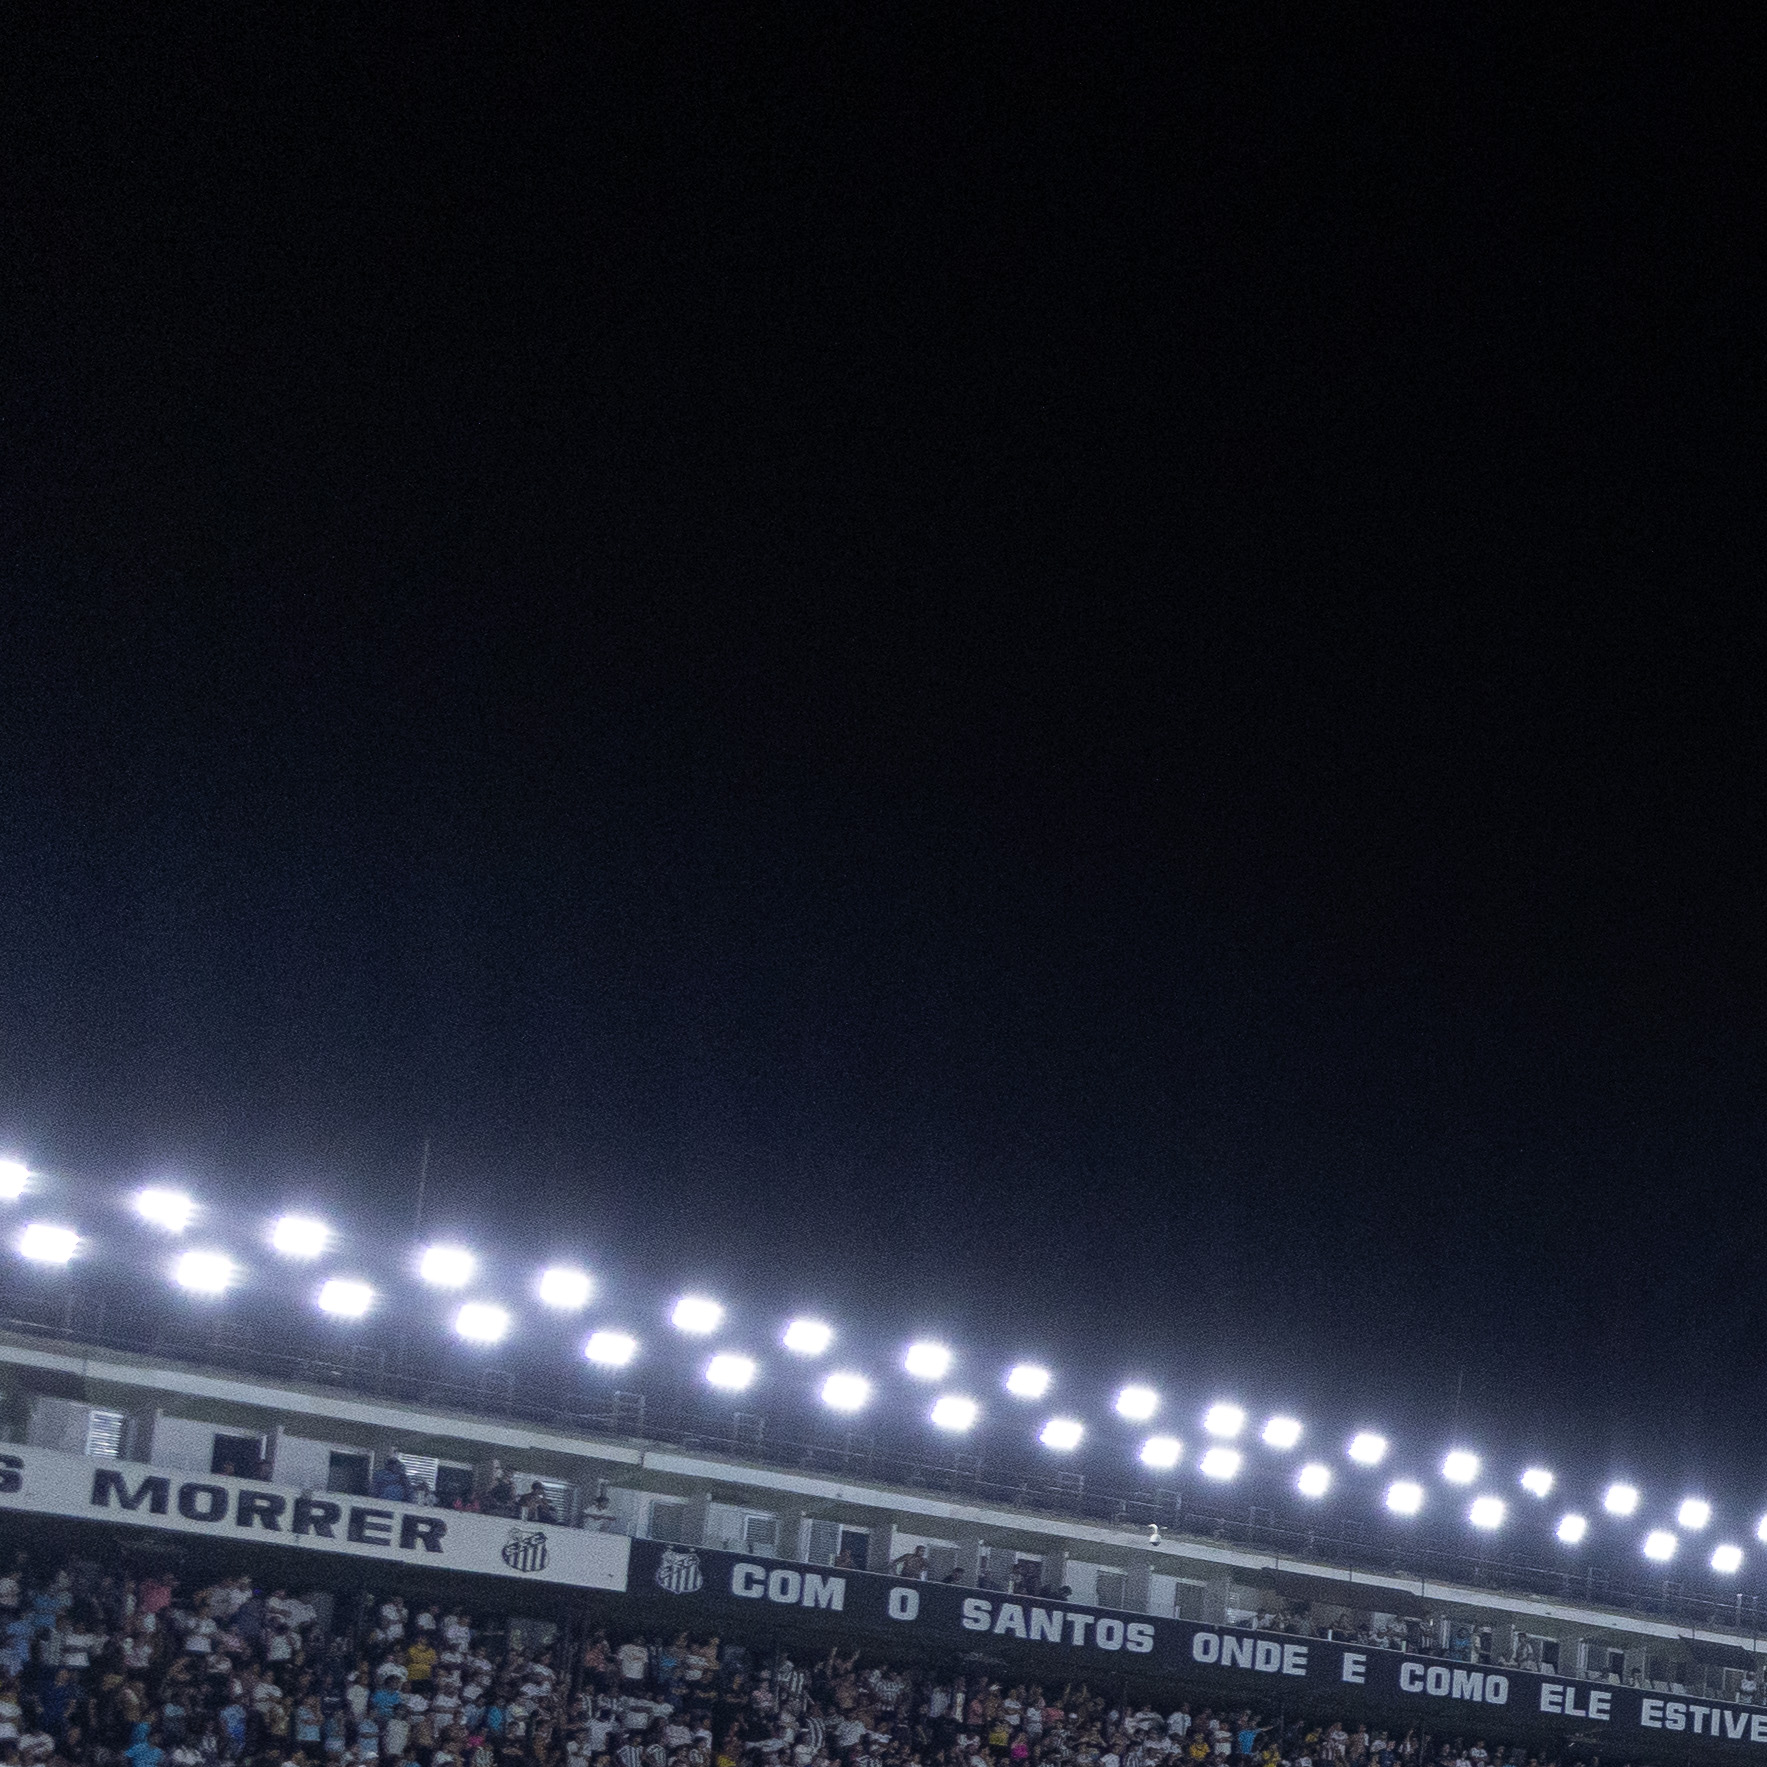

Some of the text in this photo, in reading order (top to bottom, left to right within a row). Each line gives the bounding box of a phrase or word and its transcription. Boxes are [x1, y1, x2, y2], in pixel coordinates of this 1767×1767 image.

[90, 1468, 448, 1554] MORRER
[731, 1562, 847, 1611] COM
[888, 1586, 921, 1622] O
[961, 1597, 1155, 1655] SANTOS
[1192, 1631, 1309, 1677] ONDE
[1342, 1652, 1366, 1685] E
[1399, 1660, 1509, 1706] COMO
[1540, 1683, 1613, 1722] ELE
